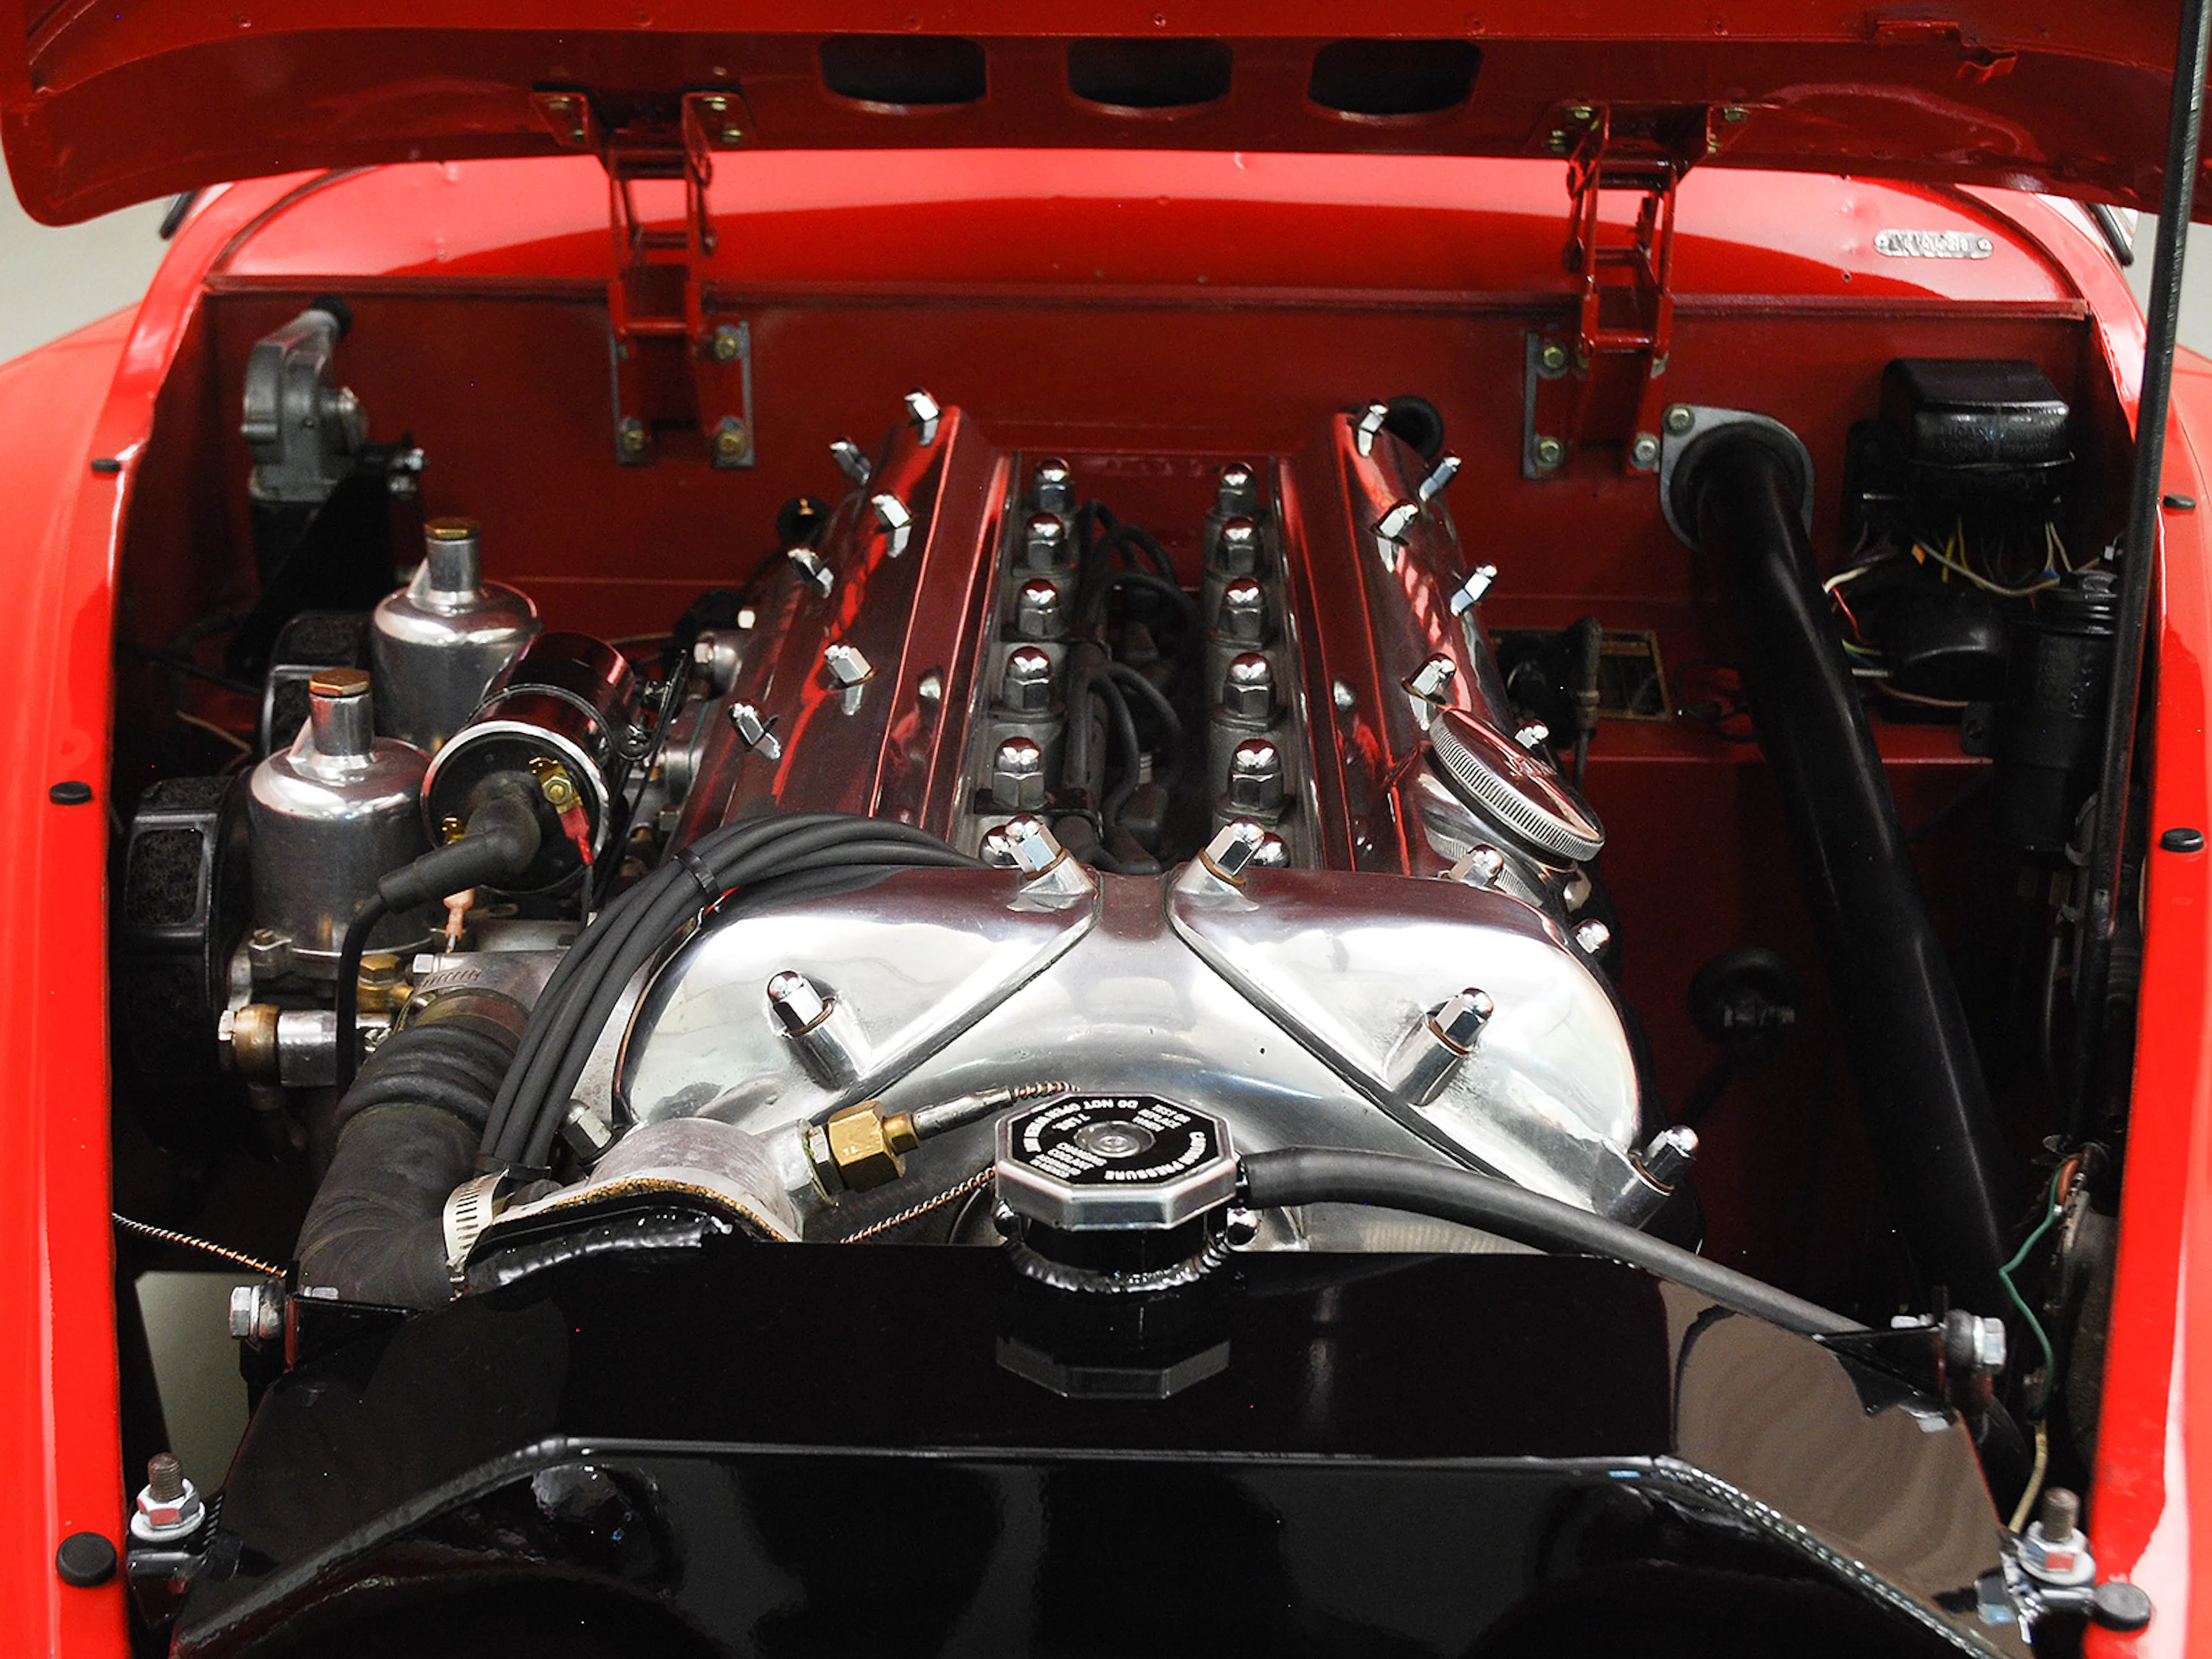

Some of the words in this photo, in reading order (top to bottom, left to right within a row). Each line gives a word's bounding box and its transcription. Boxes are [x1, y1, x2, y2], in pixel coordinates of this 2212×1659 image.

[1084, 1099, 1113, 1109] NOT
[1118, 1100, 1138, 1109] DO
[1044, 1103, 1081, 1119] OPEN
[1104, 1161, 1184, 1180] PRESSURE
